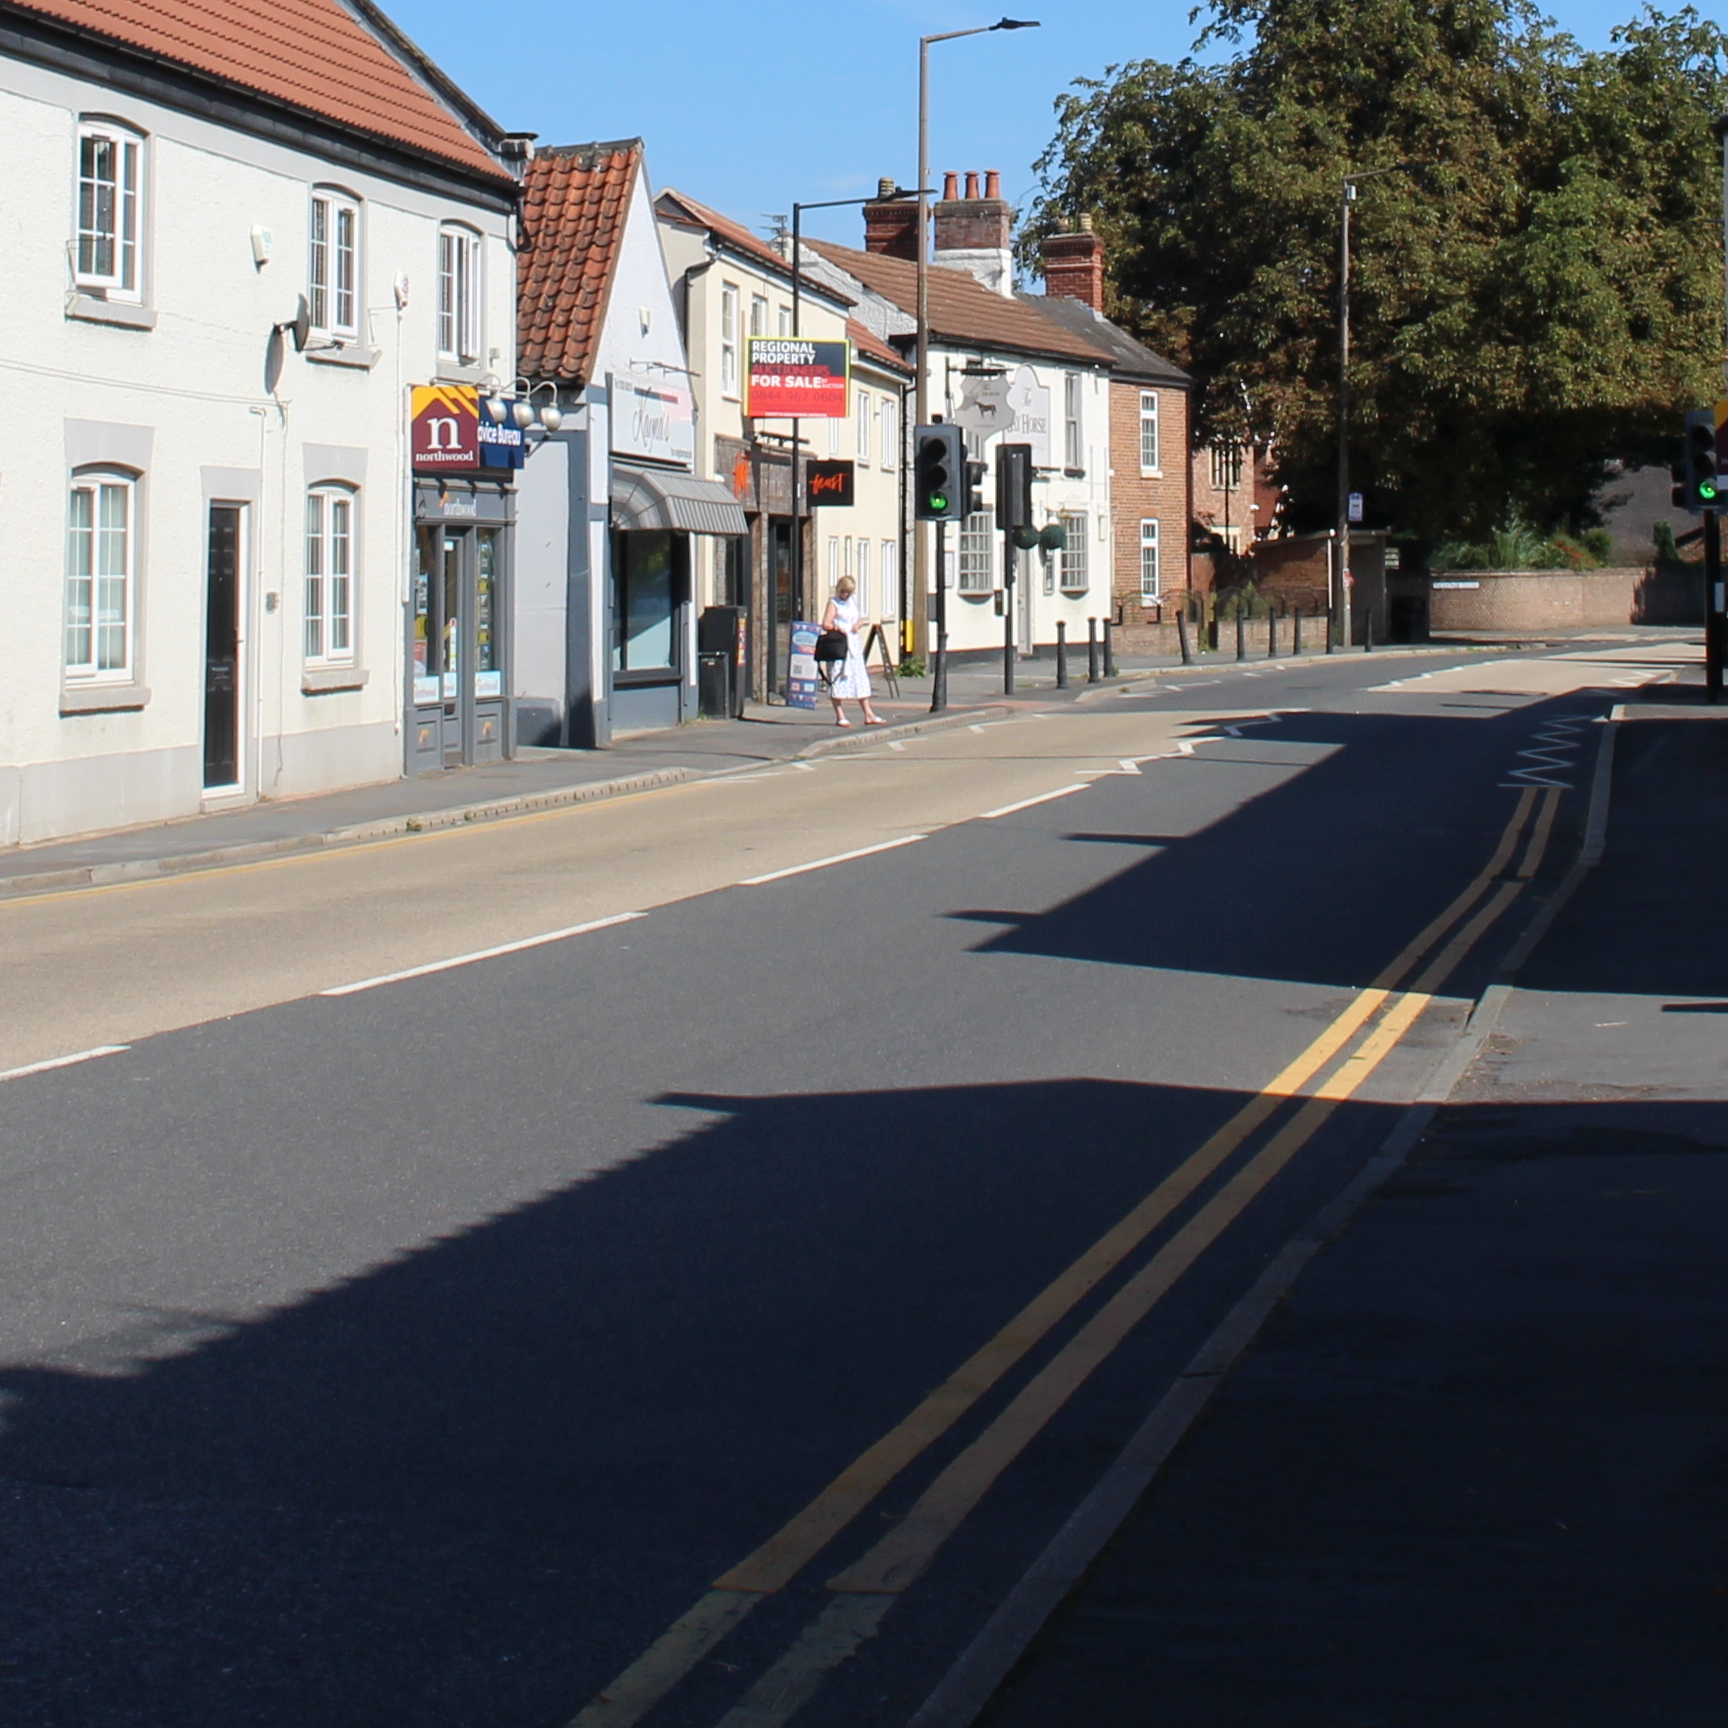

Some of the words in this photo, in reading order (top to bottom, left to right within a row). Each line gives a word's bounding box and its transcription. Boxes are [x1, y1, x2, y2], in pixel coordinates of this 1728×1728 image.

[752, 341, 816, 354] REGIONAL
[752, 352, 816, 365] PROPERTY
[751, 375, 781, 388] FOR
[785, 376, 822, 389] SALE
[415, 450, 474, 462] northwood
